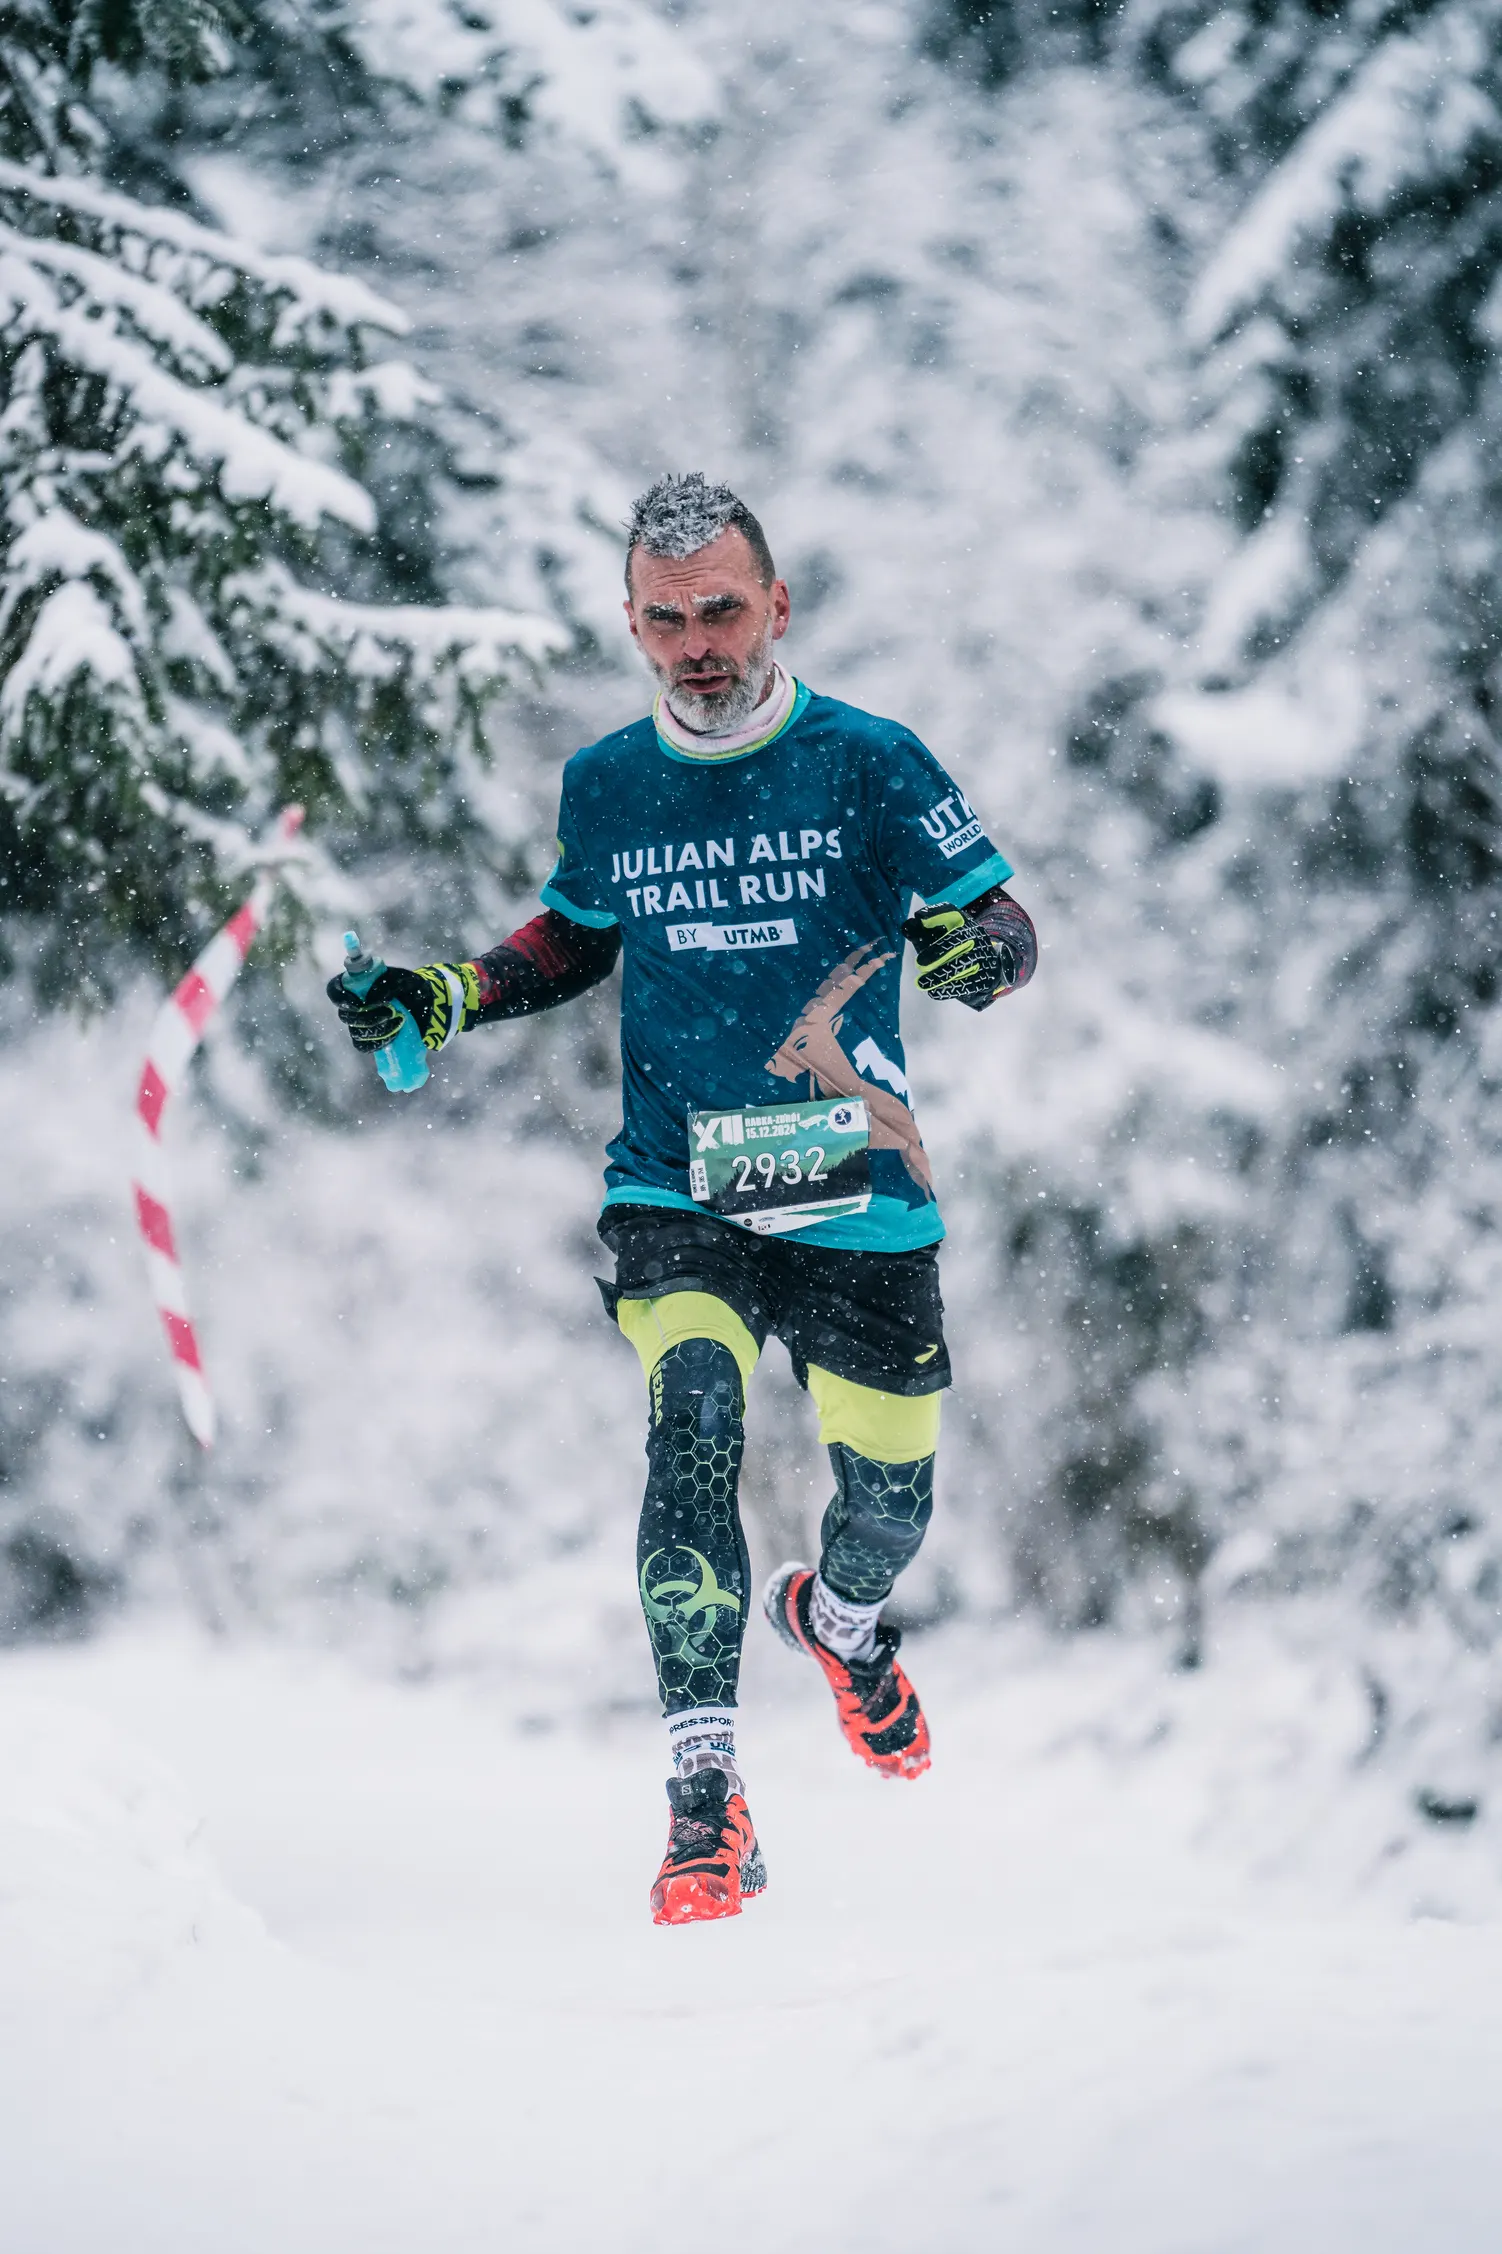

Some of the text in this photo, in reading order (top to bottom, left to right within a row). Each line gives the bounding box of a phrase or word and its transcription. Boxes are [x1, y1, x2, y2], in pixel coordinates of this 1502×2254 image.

[611, 829, 843, 884] JULIAN ALPS
[943, 823, 981, 853] WORLD
[626, 868, 826, 918] TRAIL RUN
[676, 928, 699, 946] BY
[692, 1113, 745, 1153] XII
[745, 1123, 797, 1139] 15.12.2024
[731, 1146, 828, 1192] 2932
